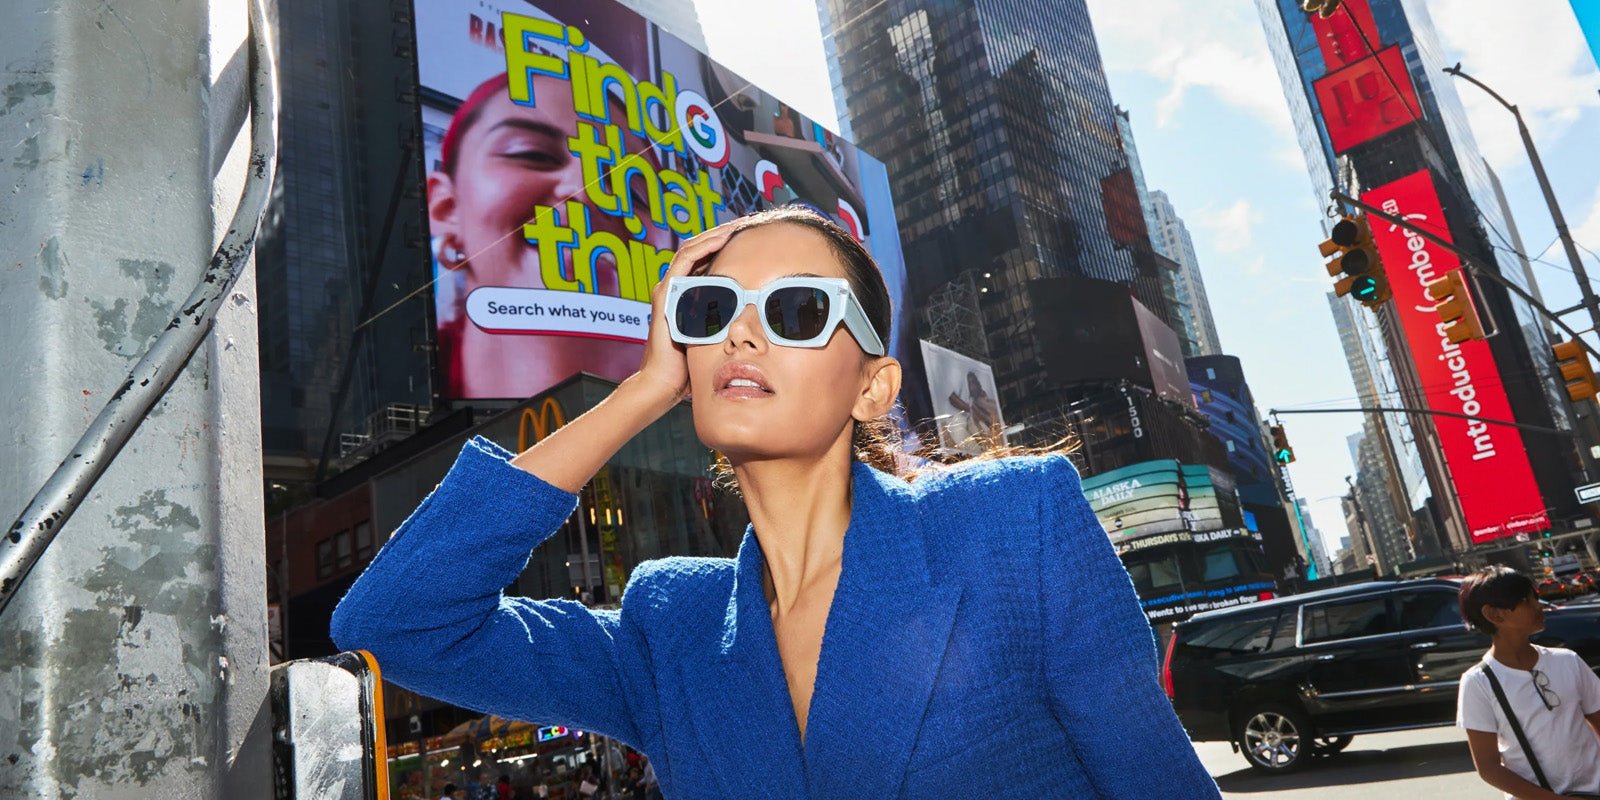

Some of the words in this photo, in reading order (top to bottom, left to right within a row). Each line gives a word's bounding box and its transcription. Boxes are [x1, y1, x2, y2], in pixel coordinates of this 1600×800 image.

[501, 11, 686, 158] Find
[567, 121, 725, 240] that
[487, 301, 544, 317] Search
[548, 304, 586, 319] what
[590, 309, 615, 323] you
[618, 313, 640, 326] see
[1127, 396, 1143, 439] 1500
[1092, 479, 1142, 501] ALASKA
[1101, 488, 1135, 506] DAILY
[1131, 532, 1179, 550] THURSDAYS
[1209, 528, 1232, 541] DAILY
[1148, 607, 1174, 619] Wentz
[1175, 604, 1184, 614] to
